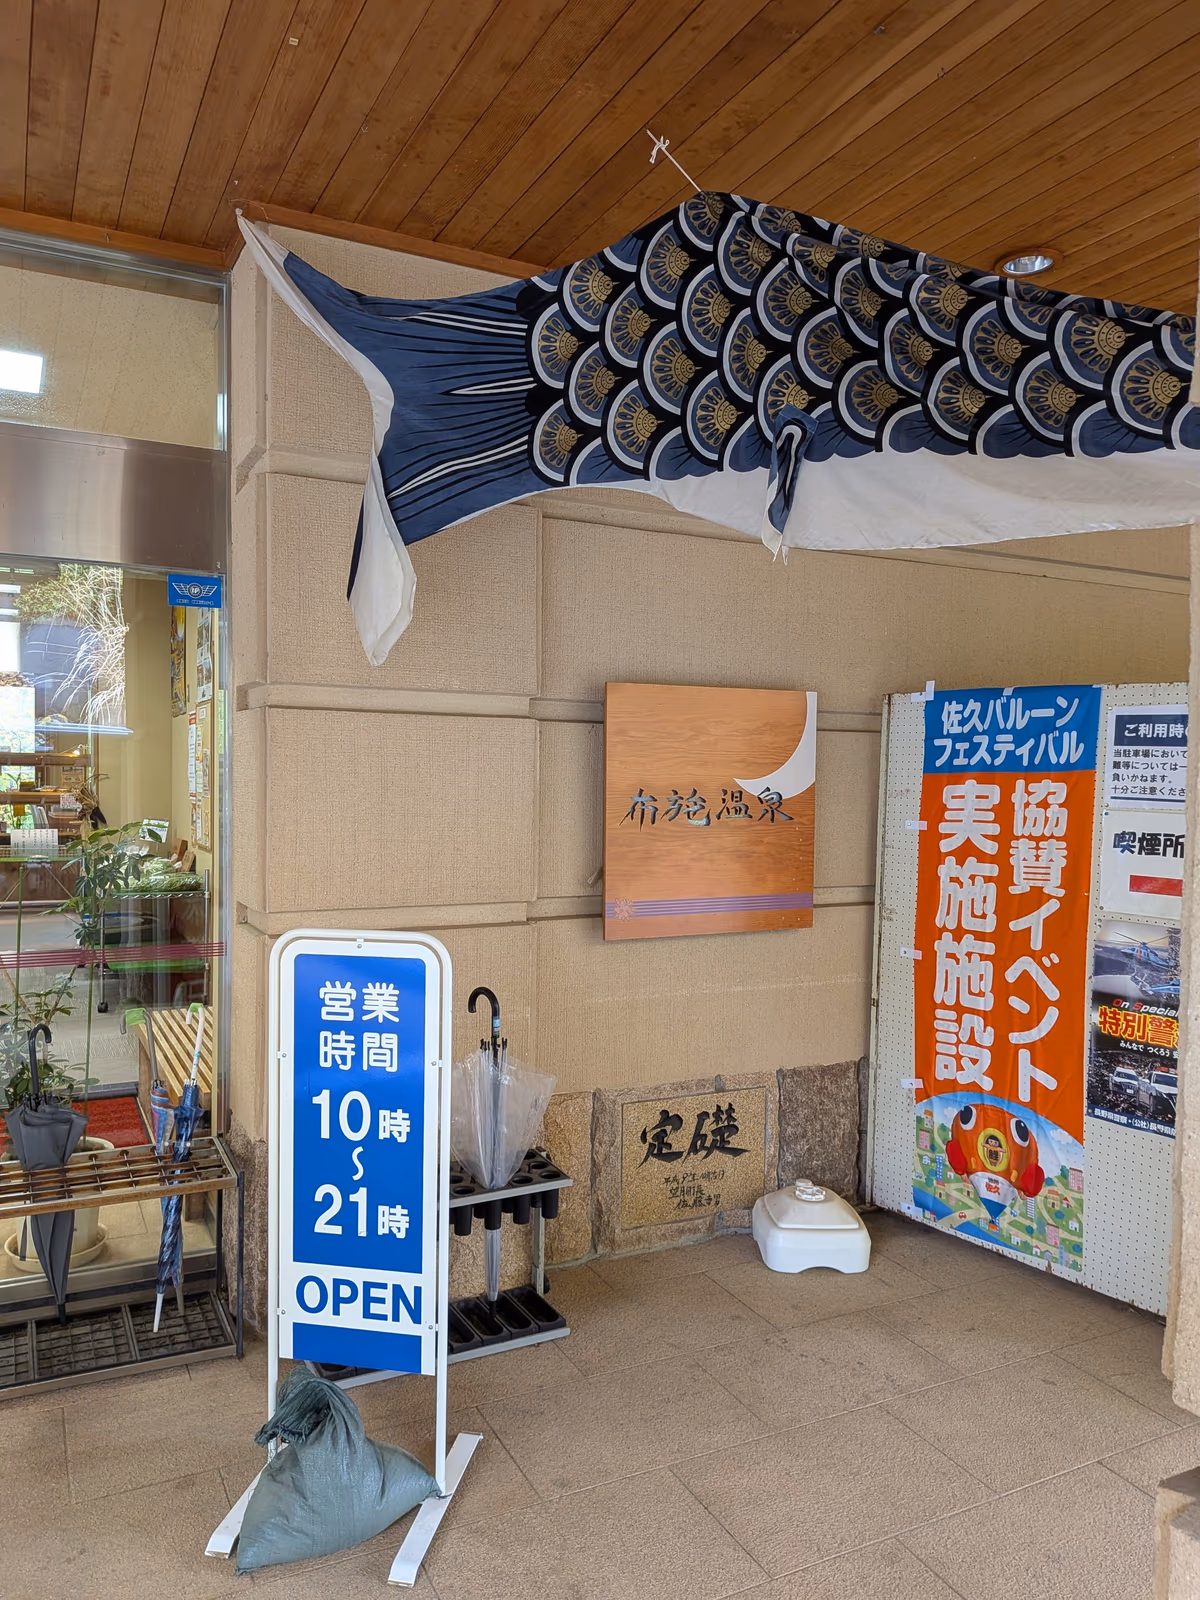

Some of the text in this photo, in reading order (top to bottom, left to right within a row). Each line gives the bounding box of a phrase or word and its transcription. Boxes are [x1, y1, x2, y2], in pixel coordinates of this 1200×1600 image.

[941, 695, 1080, 735] 佐久バルーン
[933, 730, 1085, 767] フェスティバル
[1113, 749, 1188, 758] 当駐車場において
[1111, 784, 1187, 797] 十分ご注意くださ
[1112, 772, 1173, 784] 負いかねます。
[619, 786, 795, 832] 布施温泉
[1113, 831, 1185, 858] 喫煙所
[933, 779, 1001, 1091] 実施施設
[1004, 779, 1068, 1102] 協賛イベント
[319, 980, 400, 1023] 営業
[1112, 998, 1130, 1009] On
[1098, 1005, 1178, 1049] 特別警
[319, 1030, 399, 1073] 時間
[1120, 1040, 1145, 1052] みんなで
[1147, 1046, 1170, 1058] つくろう
[312, 1088, 411, 1143] 10時
[636, 1102, 750, 1169] 定礎
[313, 1183, 410, 1239] 21時
[295, 1274, 422, 1325] OPEN
